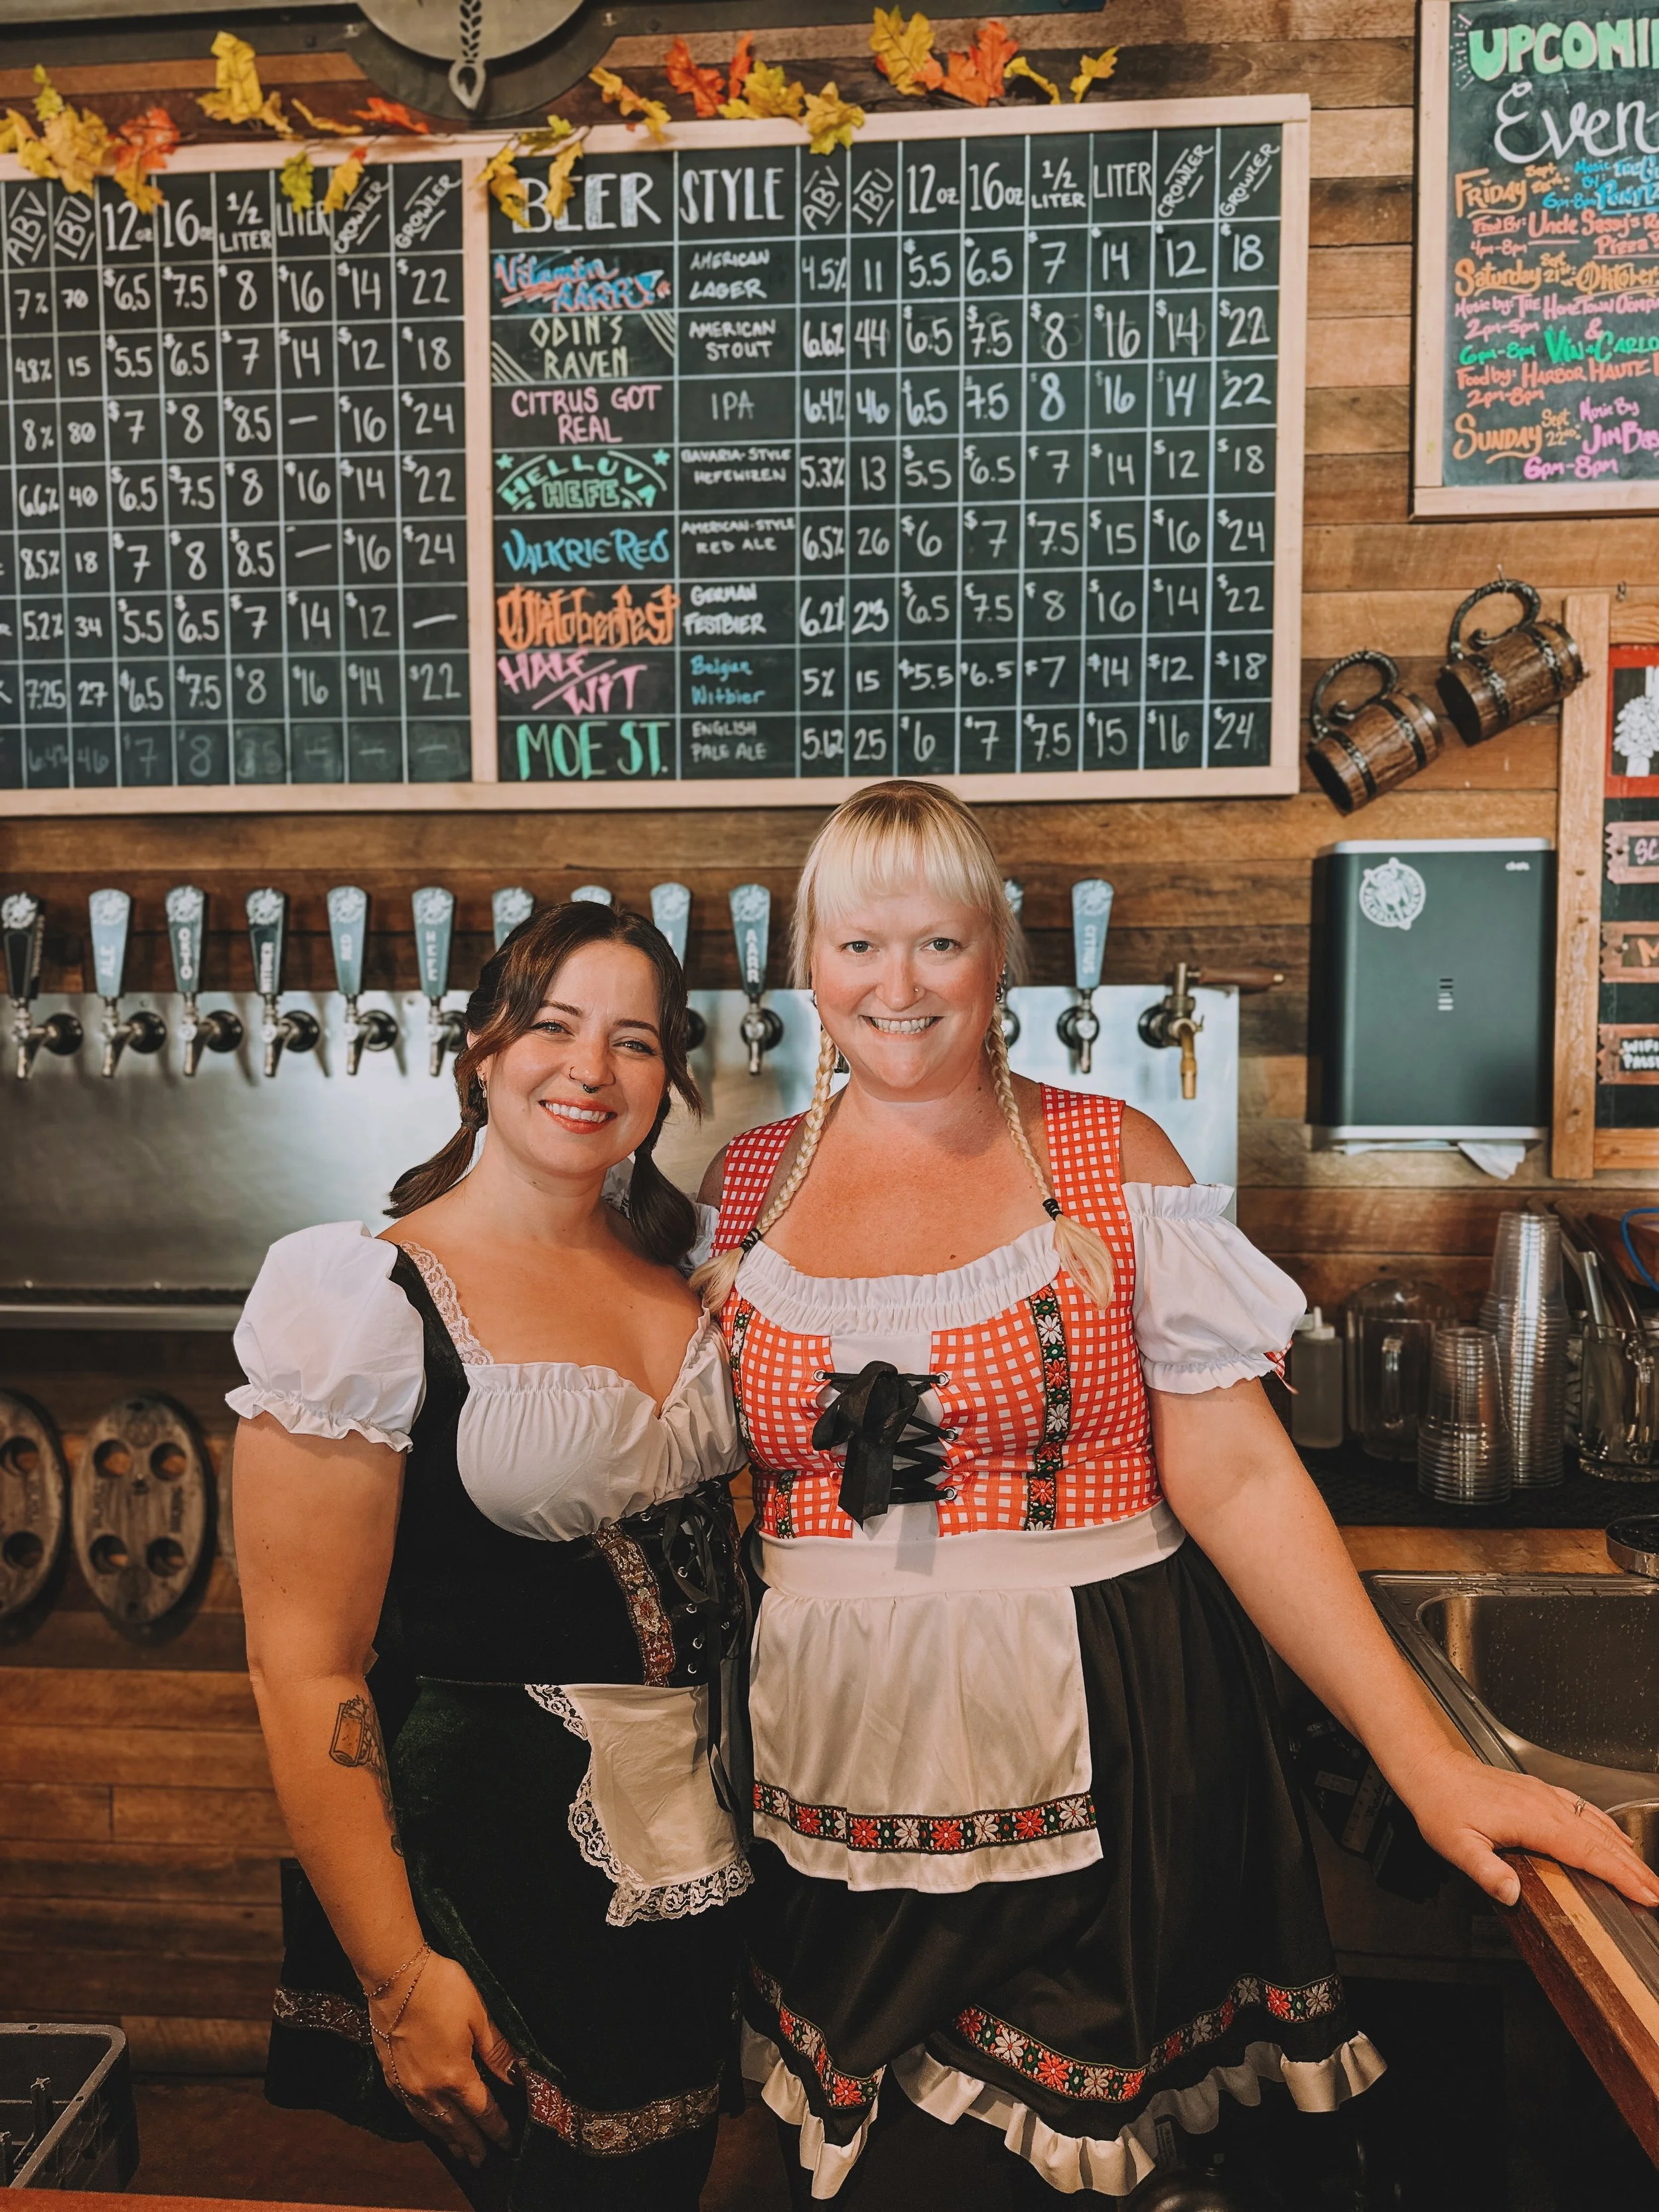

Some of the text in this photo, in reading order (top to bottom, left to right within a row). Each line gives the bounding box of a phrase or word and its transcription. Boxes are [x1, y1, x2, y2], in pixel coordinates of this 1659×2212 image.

[1469, 19, 1659, 81] UPCOMI
[1494, 82, 1659, 163] Even
[1094, 163, 1152, 198] LITER
[396, 175, 461, 248] GROWLER
[680, 168, 784, 224] STYLE
[802, 167, 840, 230] ABV
[1032, 193, 1085, 208] LITER
[7, 192, 47, 266] ABV
[54, 199, 92, 261] IBU
[1528, 209, 1579, 238] Uncle
[220, 230, 271, 252] LITER
[1594, 236, 1649, 255] Pizza
[689, 249, 770, 269] AMERICAN
[689, 277, 767, 301] LAGER
[865, 259, 883, 292] 11
[1455, 258, 1542, 297] Saturday
[15, 289, 48, 319] 7%
[62, 289, 88, 309] 70
[530, 315, 622, 348] ODIN'S
[689, 319, 776, 339] AMERICAN
[855, 319, 887, 360] 44
[1585, 317, 1605, 340] &
[544, 346, 628, 380] RAVEN
[705, 340, 772, 361] STOUT
[68, 356, 90, 378] 15
[511, 384, 662, 417] CITRUS GOT
[711, 390, 755, 421] IPA
[856, 390, 889, 425] 46
[1467, 388, 1545, 408] 2pm-8pm
[23, 419, 54, 451] 8%
[558, 415, 622, 445] REAL
[1453, 413, 1542, 459] SUNDAY
[861, 457, 887, 491] 13
[1524, 455, 1619, 480] 6pm-8pm
[68, 486, 98, 506] 40
[542, 480, 620, 509] HEFE
[609, 528, 670, 570] RED
[696, 537, 777, 555] RED ALE
[857, 528, 889, 555] 26
[76, 552, 98, 573] 18
[690, 583, 757, 607] GERMAN
[74, 617, 103, 638] 34
[682, 611, 766, 636] FESTBIER
[498, 646, 589, 694] HALF
[803, 669, 834, 697] 5%
[856, 669, 879, 693] 15
[78, 681, 108, 707] 27
[691, 686, 766, 705] Witbier
[691, 721, 757, 739] ENGLISH
[516, 721, 608, 780] MOE
[691, 745, 768, 763] PALE ALE
[854, 729, 887, 761] 25
